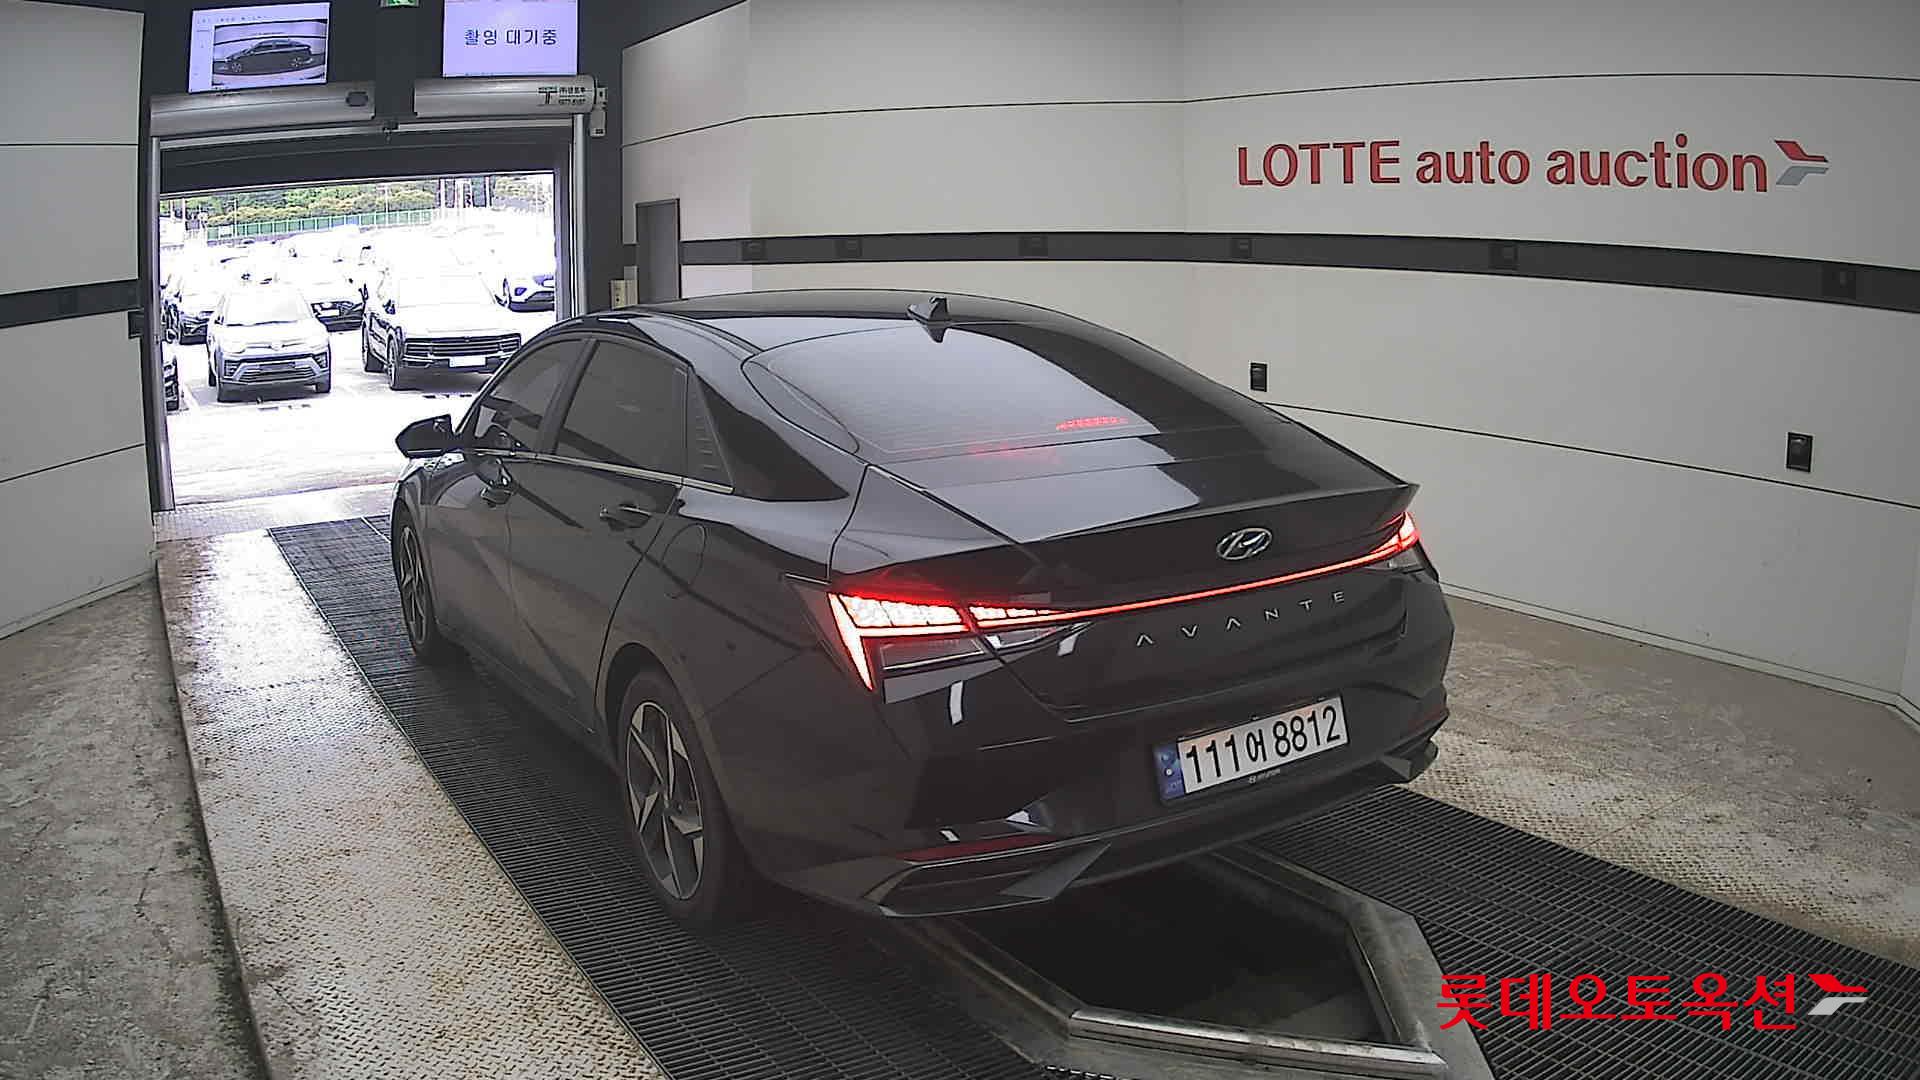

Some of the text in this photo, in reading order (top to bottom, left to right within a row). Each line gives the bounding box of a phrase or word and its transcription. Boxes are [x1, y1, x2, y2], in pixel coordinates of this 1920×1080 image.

[464, 28, 558, 46] 촬영 대기중
[1238, 133, 1769, 194] LOTTE auto auction
[1136, 591, 1346, 647] AVANTE
[1272, 705, 1341, 758] 8812
